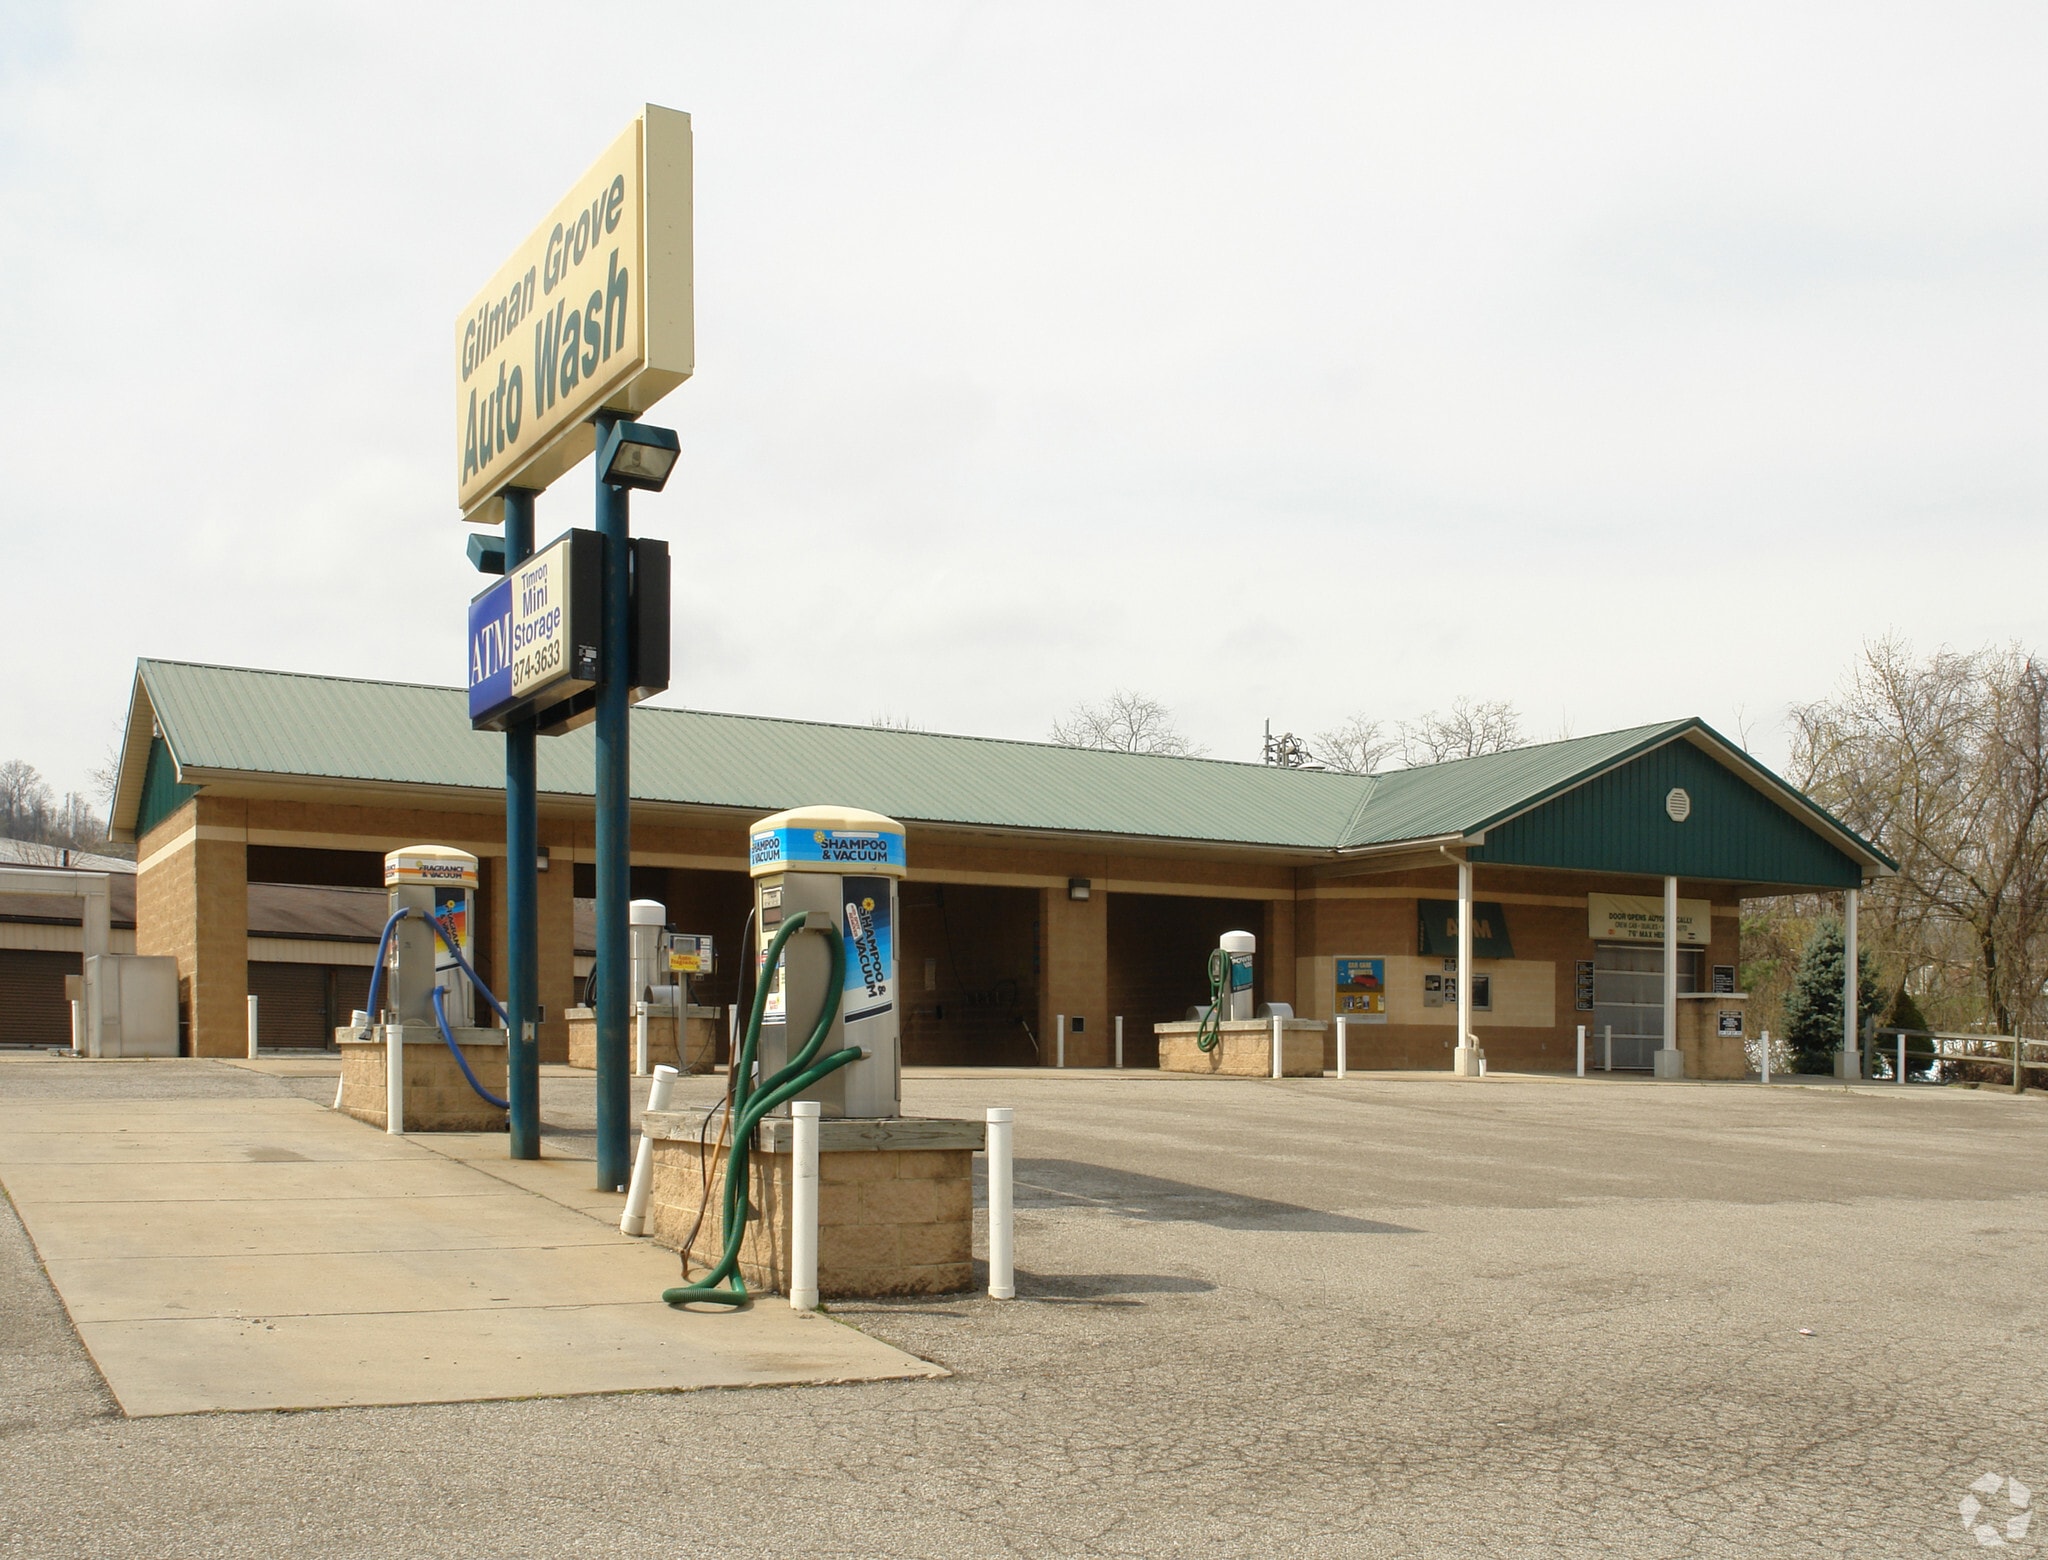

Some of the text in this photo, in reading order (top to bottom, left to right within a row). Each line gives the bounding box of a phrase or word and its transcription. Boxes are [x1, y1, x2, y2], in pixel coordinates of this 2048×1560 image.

[461, 173, 625, 383] Gilman Grove
[461, 247, 629, 487] Auto Wash
[521, 563, 548, 590] Timron
[522, 578, 548, 618] Mini
[470, 611, 512, 687] ATM
[514, 606, 560, 652] Storage
[513, 639, 560, 687] 374-3633
[820, 838, 887, 851] SHAMPOO
[822, 850, 888, 862] & VACUUM
[1446, 917, 1493, 939] AM
[1608, 912, 1626, 920] DOOR
[1627, 913, 1647, 921] OPENS
[1639, 930, 1652, 938] MAX
[855, 936, 878, 998] VACUUM
[858, 905, 887, 997] SHAMPOO &
